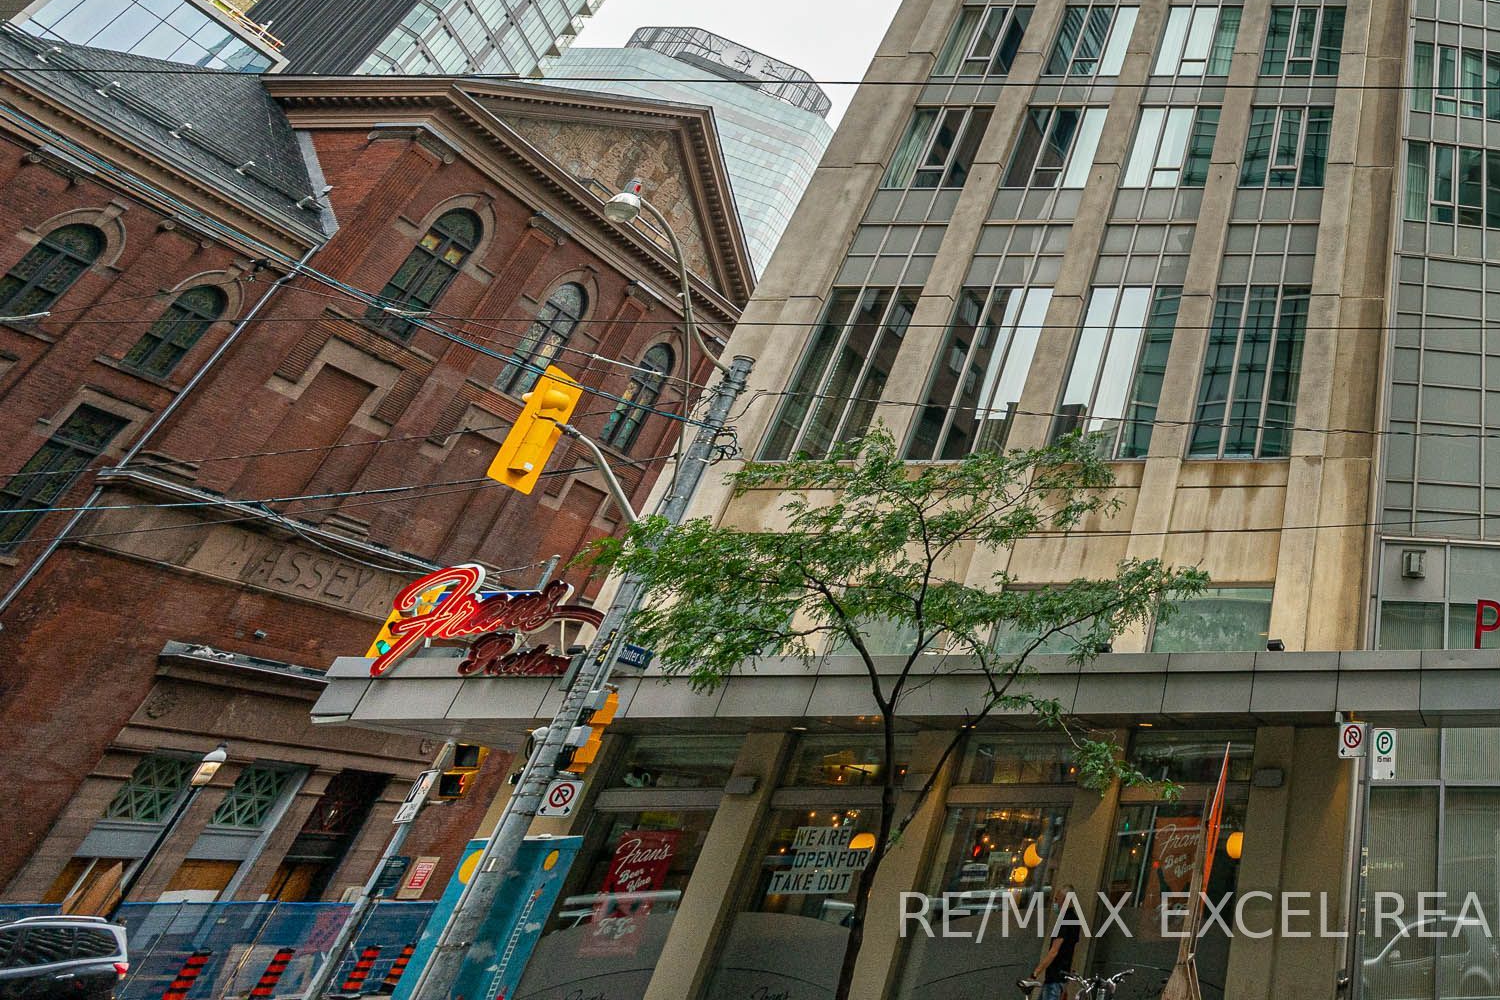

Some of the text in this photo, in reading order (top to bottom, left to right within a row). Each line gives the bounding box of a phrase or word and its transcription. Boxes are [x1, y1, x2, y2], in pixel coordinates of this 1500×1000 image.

[222, 535, 376, 604] MASSEY
[794, 829, 850, 846] WE ARE
[1154, 823, 1201, 860] Fran
[615, 838, 673, 875] Fran's
[793, 850, 869, 868] OPEN FOR
[773, 873, 851, 891] TAKE OUT
